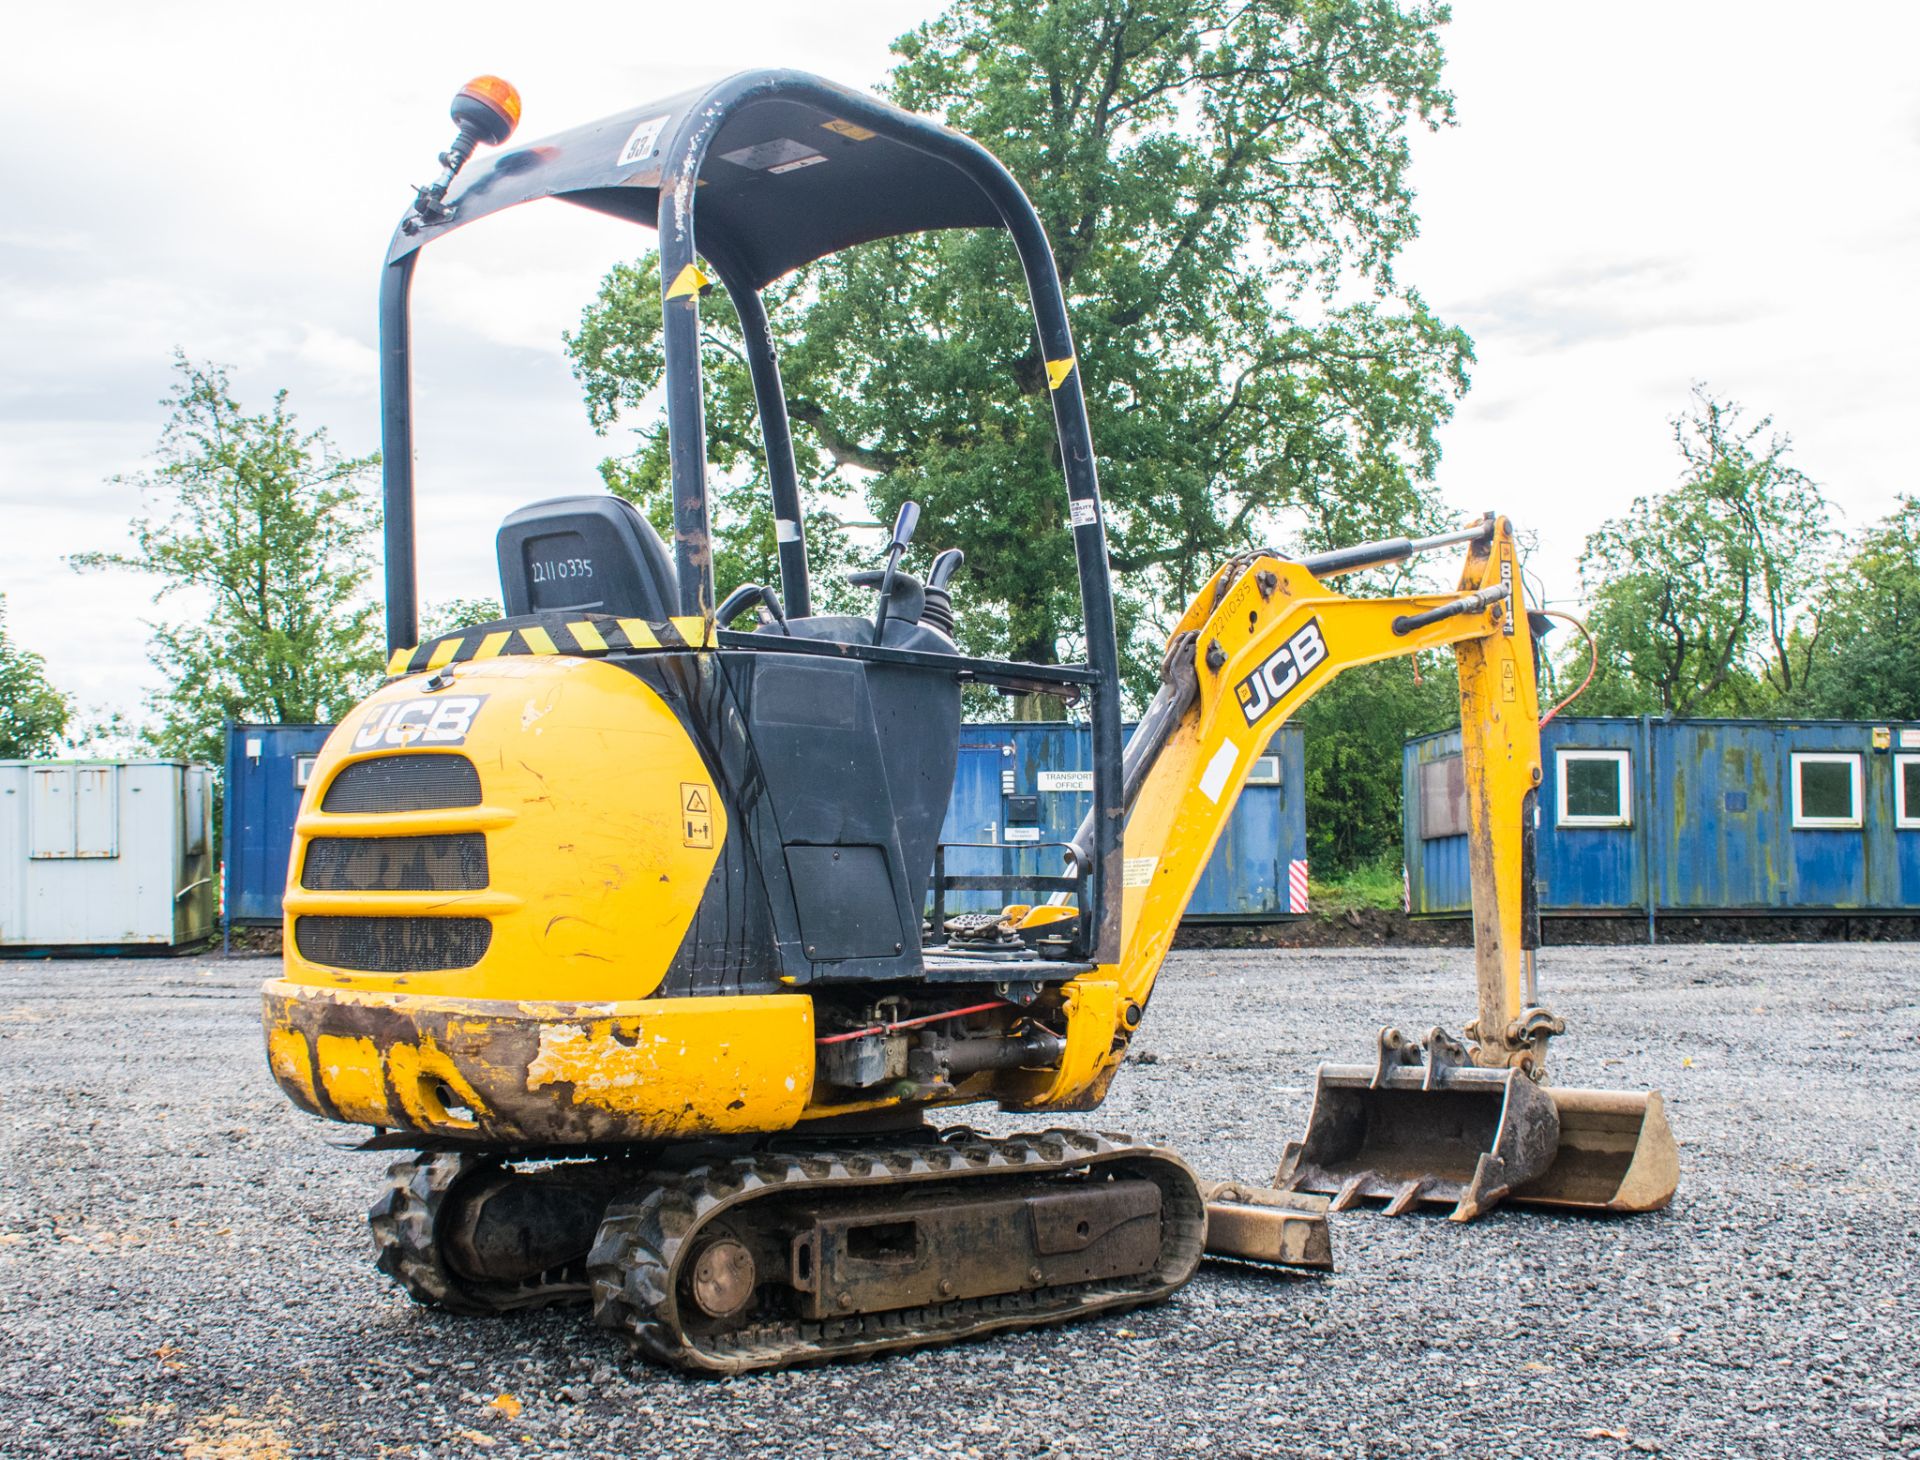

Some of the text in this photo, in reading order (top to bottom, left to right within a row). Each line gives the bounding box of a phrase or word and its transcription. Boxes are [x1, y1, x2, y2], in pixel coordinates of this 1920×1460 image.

[532, 558, 593, 583] 22110335
[1211, 581, 1251, 639] 22110335
[1244, 624, 1326, 721] JCB
[354, 698, 480, 748] JCB
[1055, 781, 1084, 789] OFFICE
